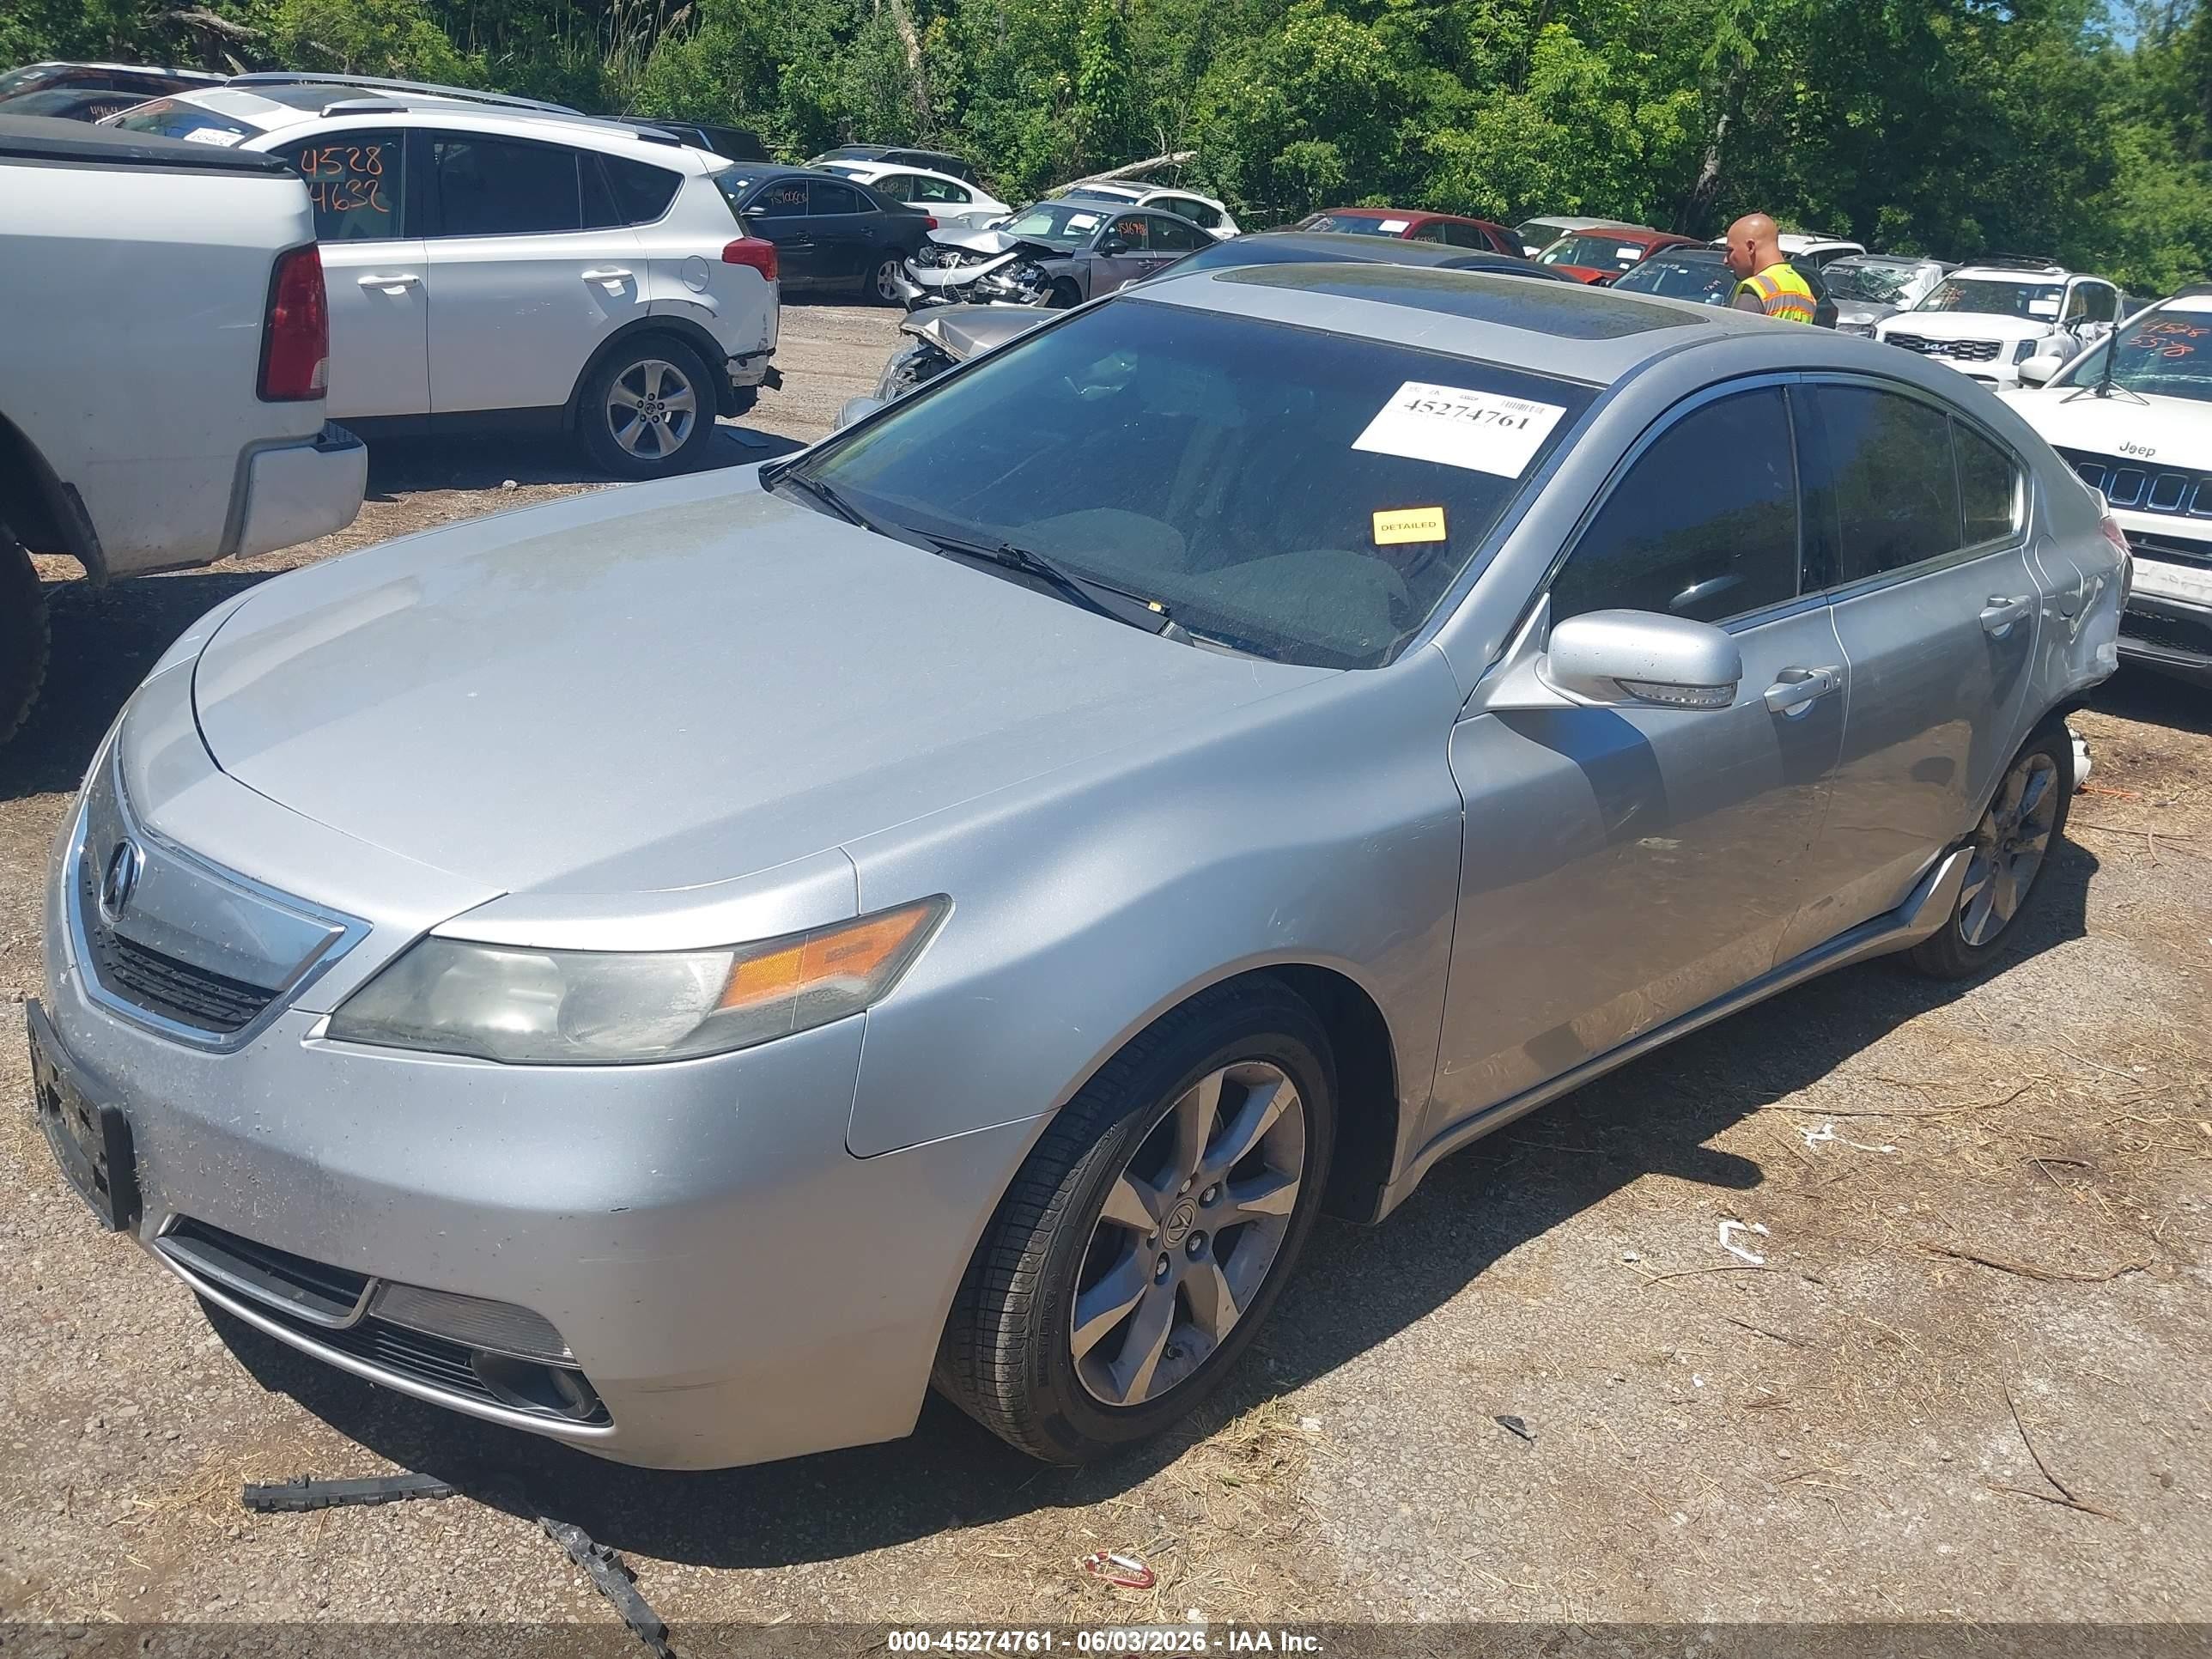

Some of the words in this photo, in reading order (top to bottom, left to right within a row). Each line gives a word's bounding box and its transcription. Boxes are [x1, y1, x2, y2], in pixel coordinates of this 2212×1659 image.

[301, 146, 383, 178] 4528
[309, 179, 390, 213] 4632
[2142, 318, 2211, 337] 4528
[1404, 398, 1531, 429] 45274761
[2118, 441, 2156, 458] Jeep
[1381, 521, 1437, 532] DETAILED
